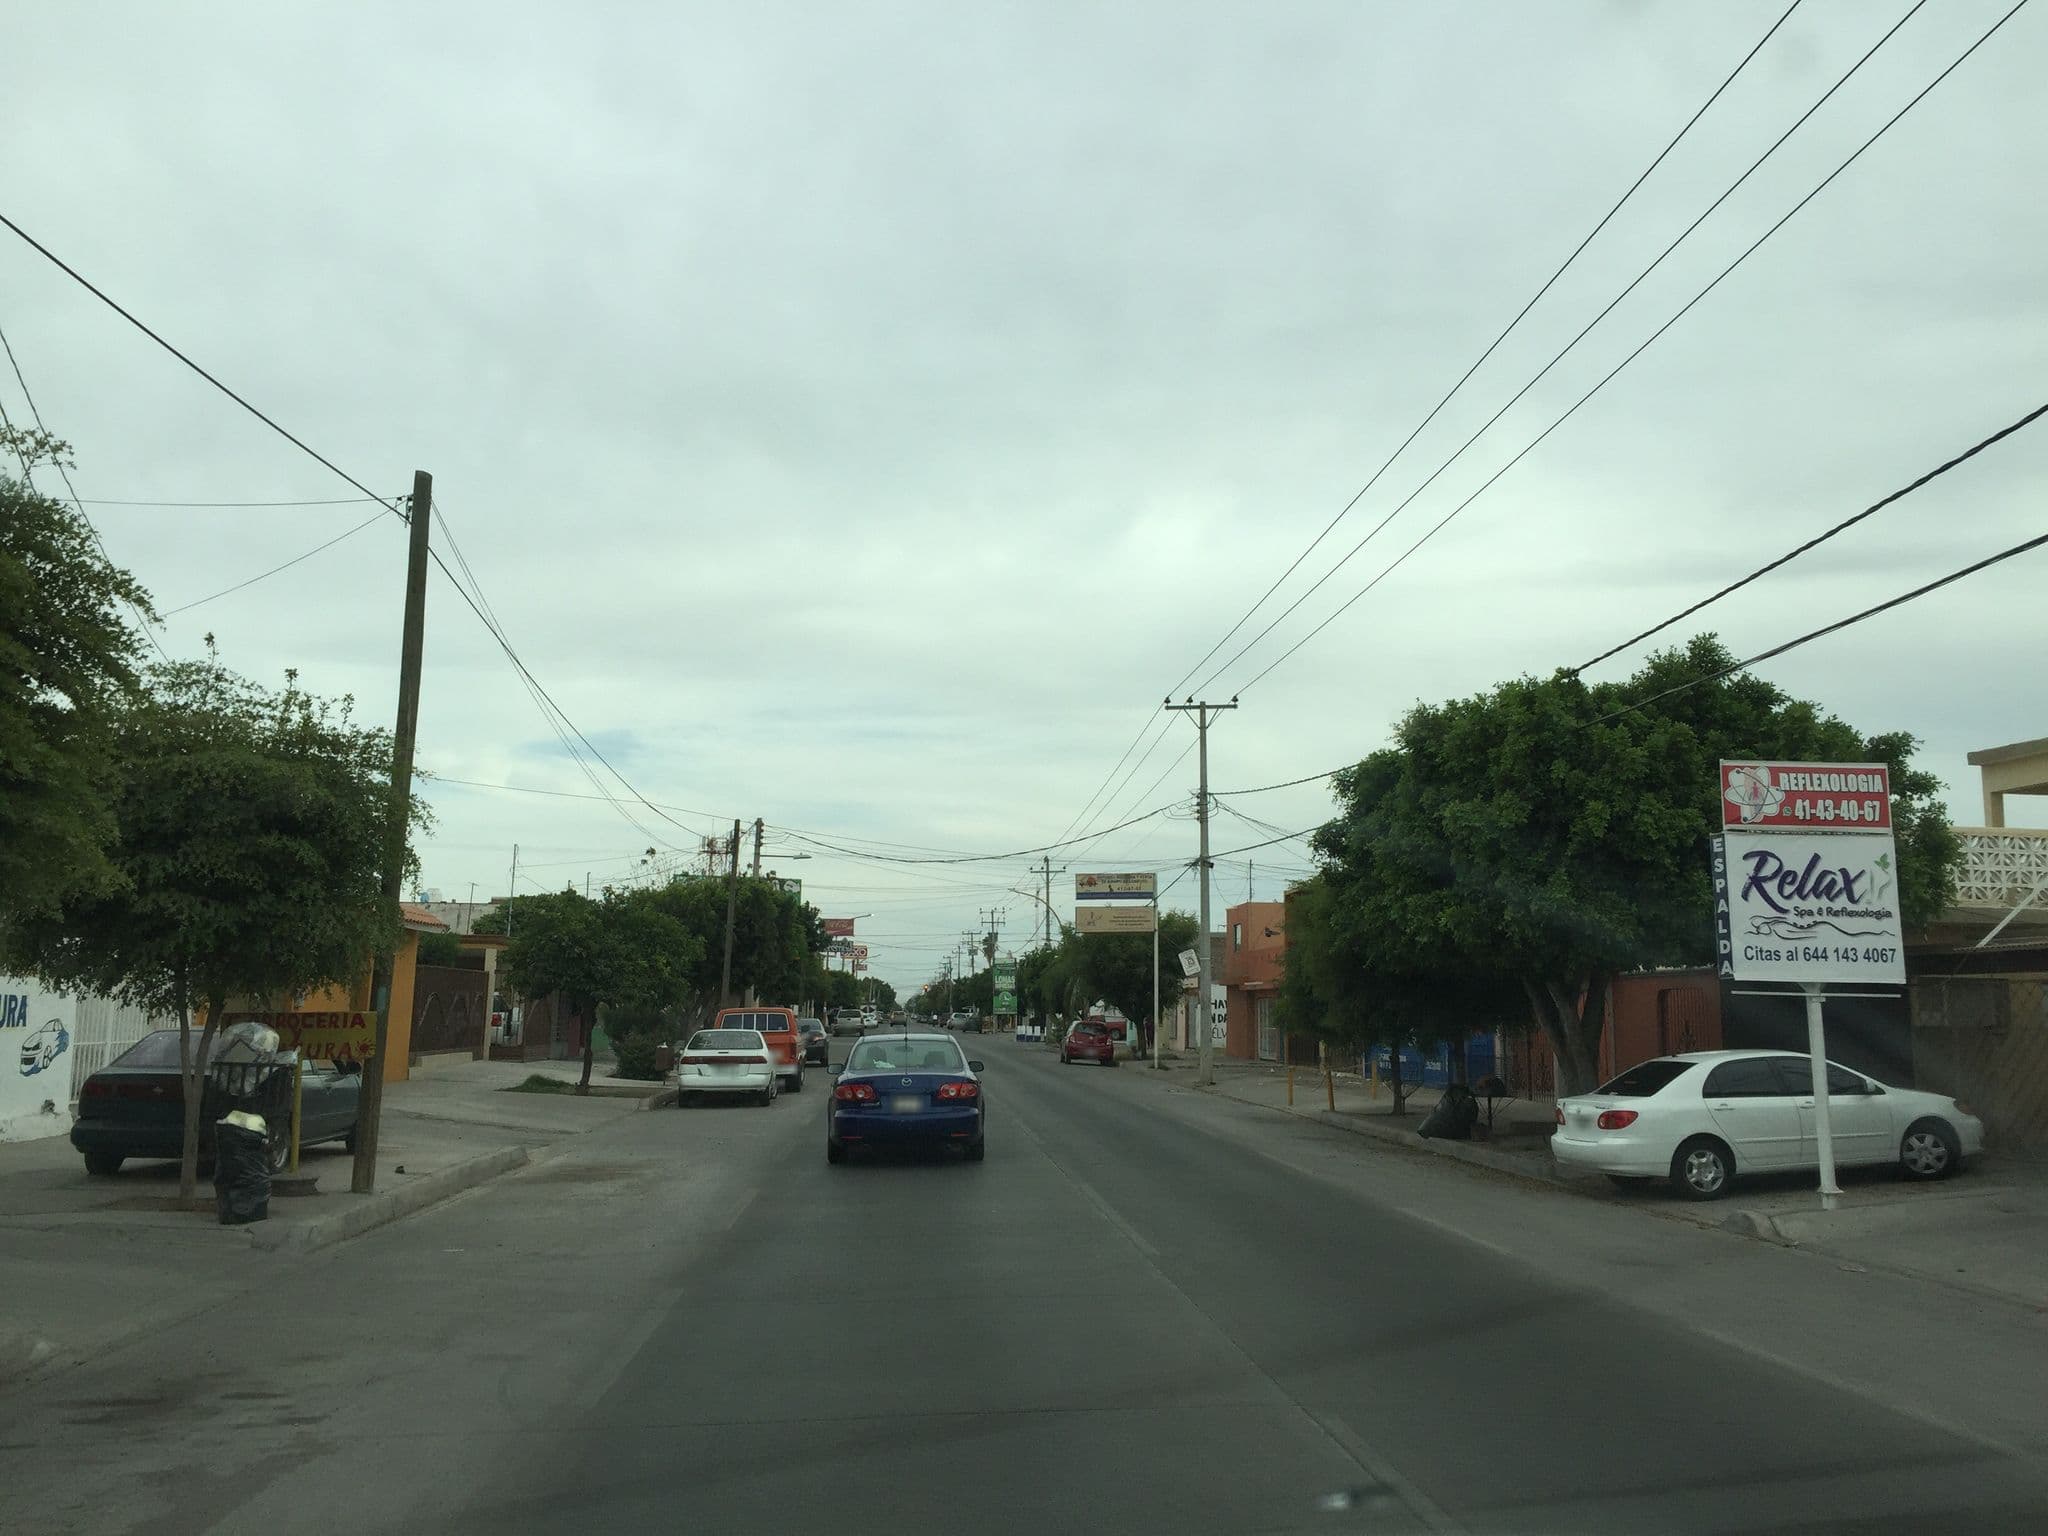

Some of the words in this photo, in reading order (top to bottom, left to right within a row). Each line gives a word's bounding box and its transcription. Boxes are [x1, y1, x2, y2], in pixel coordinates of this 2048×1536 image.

[1778, 772, 1884, 793] REFLEXOLOGIA
[1794, 798, 1881, 822] 41-43-40-67
[1741, 850, 1867, 914] Relax
[1712, 837, 1734, 975] ESPALDA
[1793, 906, 1814, 919] Spa
[1826, 906, 1892, 920] Reflexologia
[1744, 946, 1781, 962] Citas
[1786, 947, 1799, 962] al
[1803, 947, 1829, 962] 644
[1834, 947, 1858, 963] 143
[1863, 948, 1897, 963] 4067
